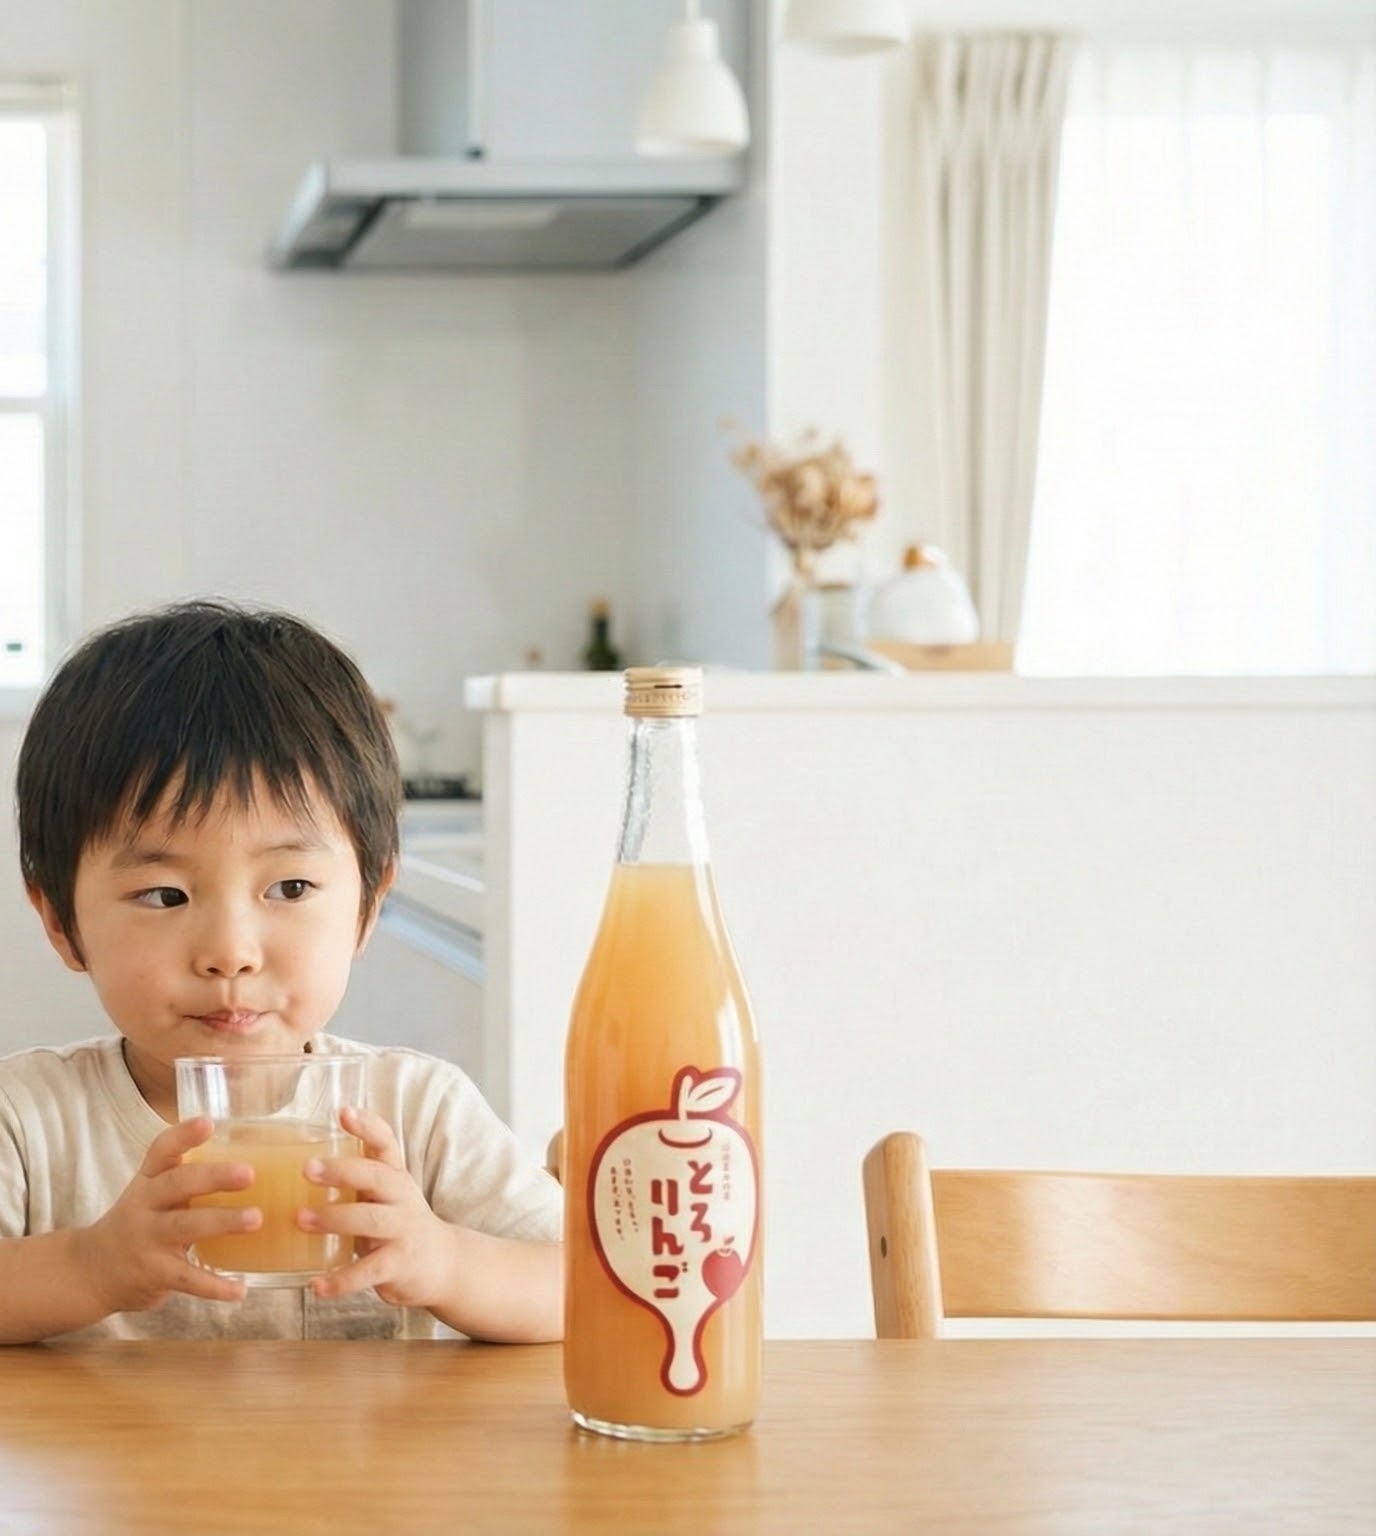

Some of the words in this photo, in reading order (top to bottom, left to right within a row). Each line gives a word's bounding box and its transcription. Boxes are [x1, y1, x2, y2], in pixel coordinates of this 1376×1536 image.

[651, 1179, 688, 1298] りんご
[687, 1160, 713, 1243] とろ
